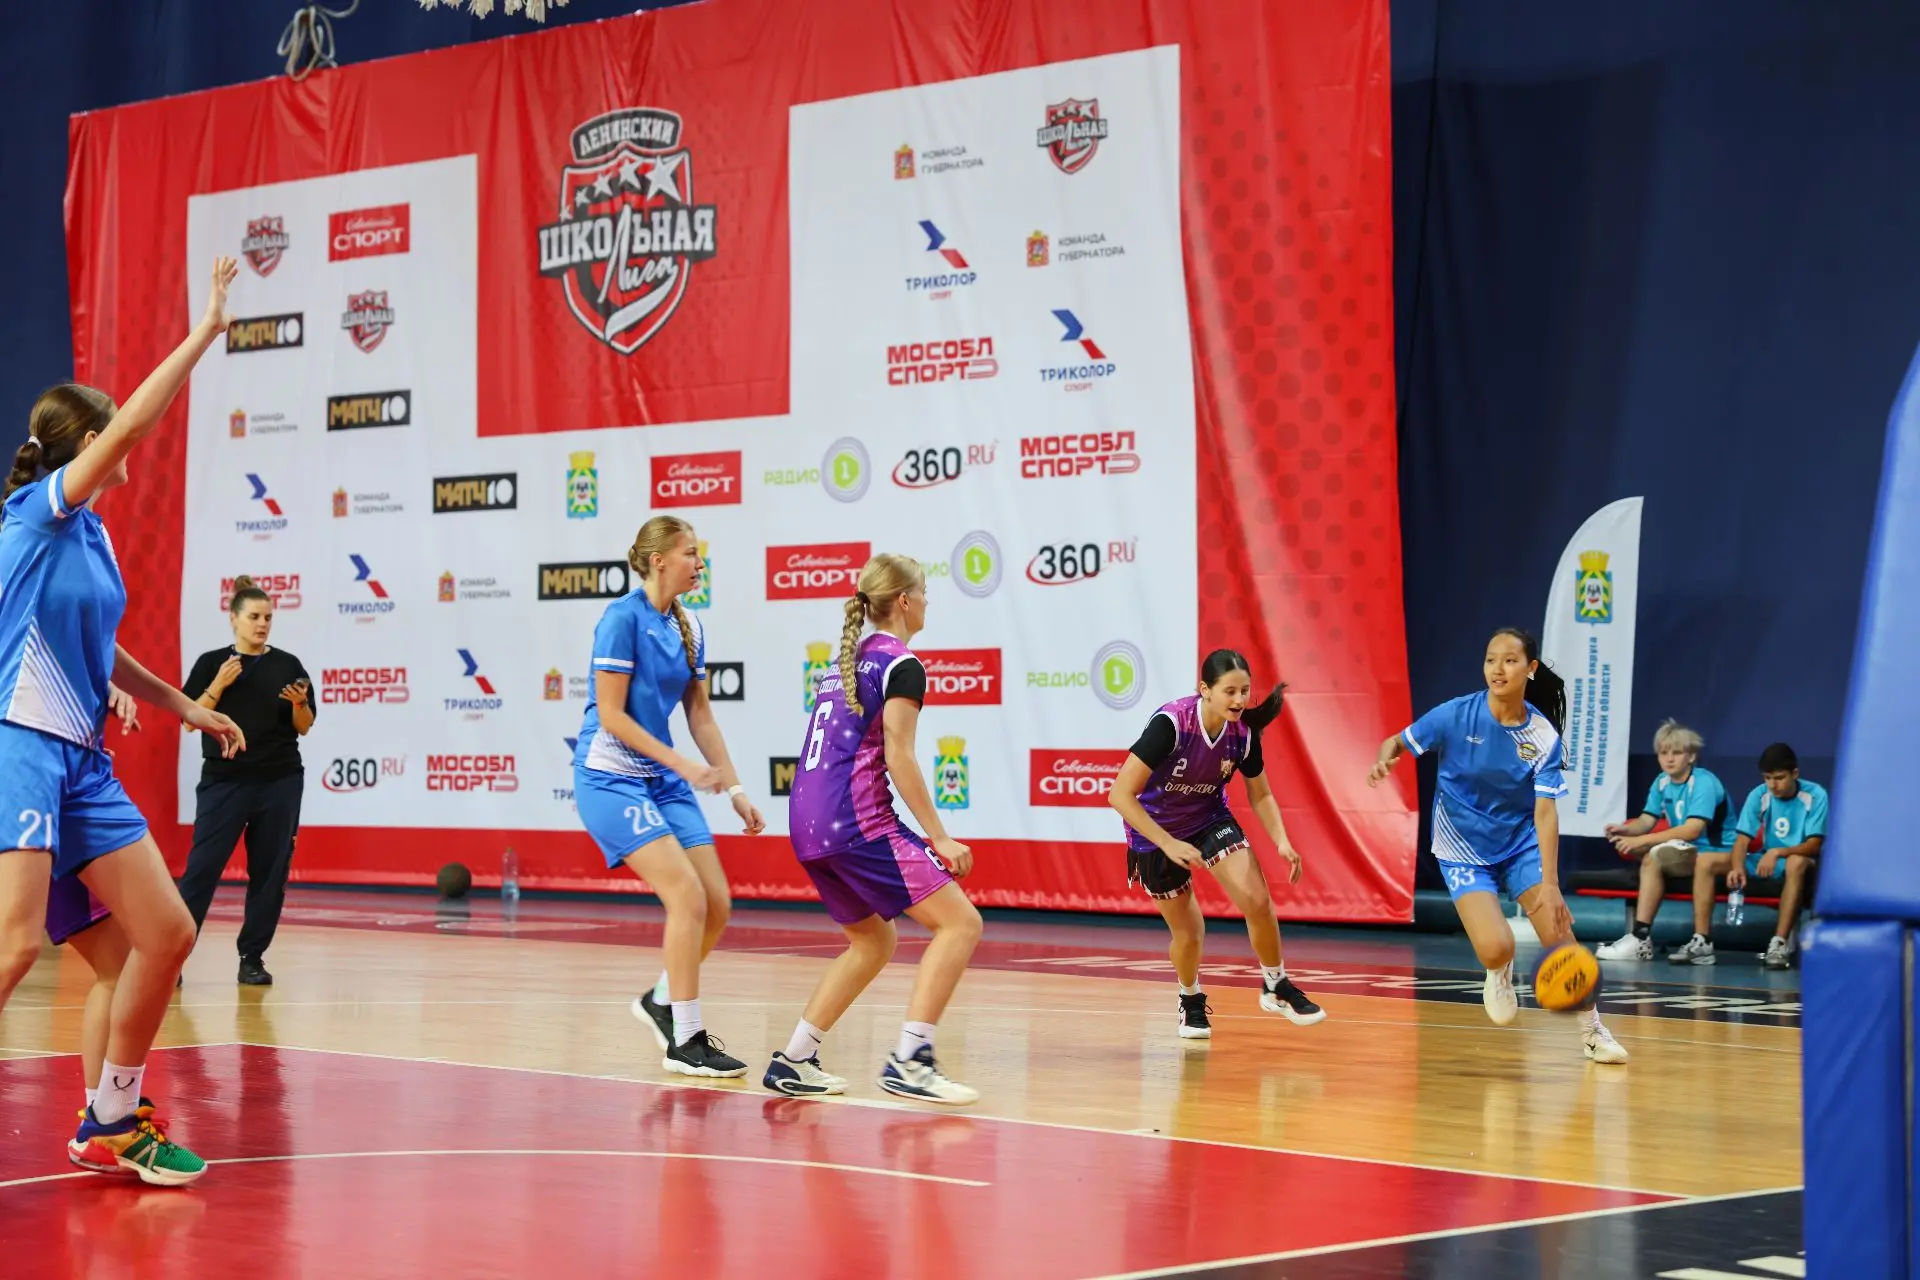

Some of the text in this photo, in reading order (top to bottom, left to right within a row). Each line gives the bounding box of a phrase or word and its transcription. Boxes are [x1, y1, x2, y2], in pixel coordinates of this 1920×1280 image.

[921, 146, 967, 160] КОМАНДА
[922, 158, 984, 174] ГУБЕРНАТОРА
[334, 228, 404, 251] СПОРТ
[539, 207, 714, 271] ШКОЛЬНАЯ
[1058, 233, 1106, 247] КОМАНДА
[1058, 246, 1125, 262] ГУБЕРНАТОРА
[905, 272, 977, 291] ТРИКОЛОР
[888, 361, 969, 386] СПОРТ
[1040, 364, 1116, 382] ТРИКОЛОР
[904, 444, 995, 483] 360 RU
[1021, 455, 1109, 478] СПОРТ
[657, 476, 735, 497] СПОРТ
[236, 519, 288, 532] ТРИКОЛОР
[1038, 541, 1135, 580] 360 RU
[773, 568, 861, 588] СПОРТ
[338, 602, 395, 614] ТРИКОЛОР
[925, 675, 994, 694] ПОРТ
[322, 687, 386, 703] СПОРТ
[444, 699, 502, 711] ТРИКОЛОР
[805, 700, 833, 772] 6
[331, 757, 404, 787] 360 RU
[1172, 758, 1188, 777] 2
[427, 775, 496, 791] СПОРТ
[1040, 776, 1115, 795] СПОР
[623, 800, 664, 835] 26
[17, 809, 53, 850] 21
[1216, 827, 1233, 839] ШФК
[1775, 817, 1790, 838] 9
[925, 846, 946, 871] 6
[1448, 867, 1476, 891] 33
